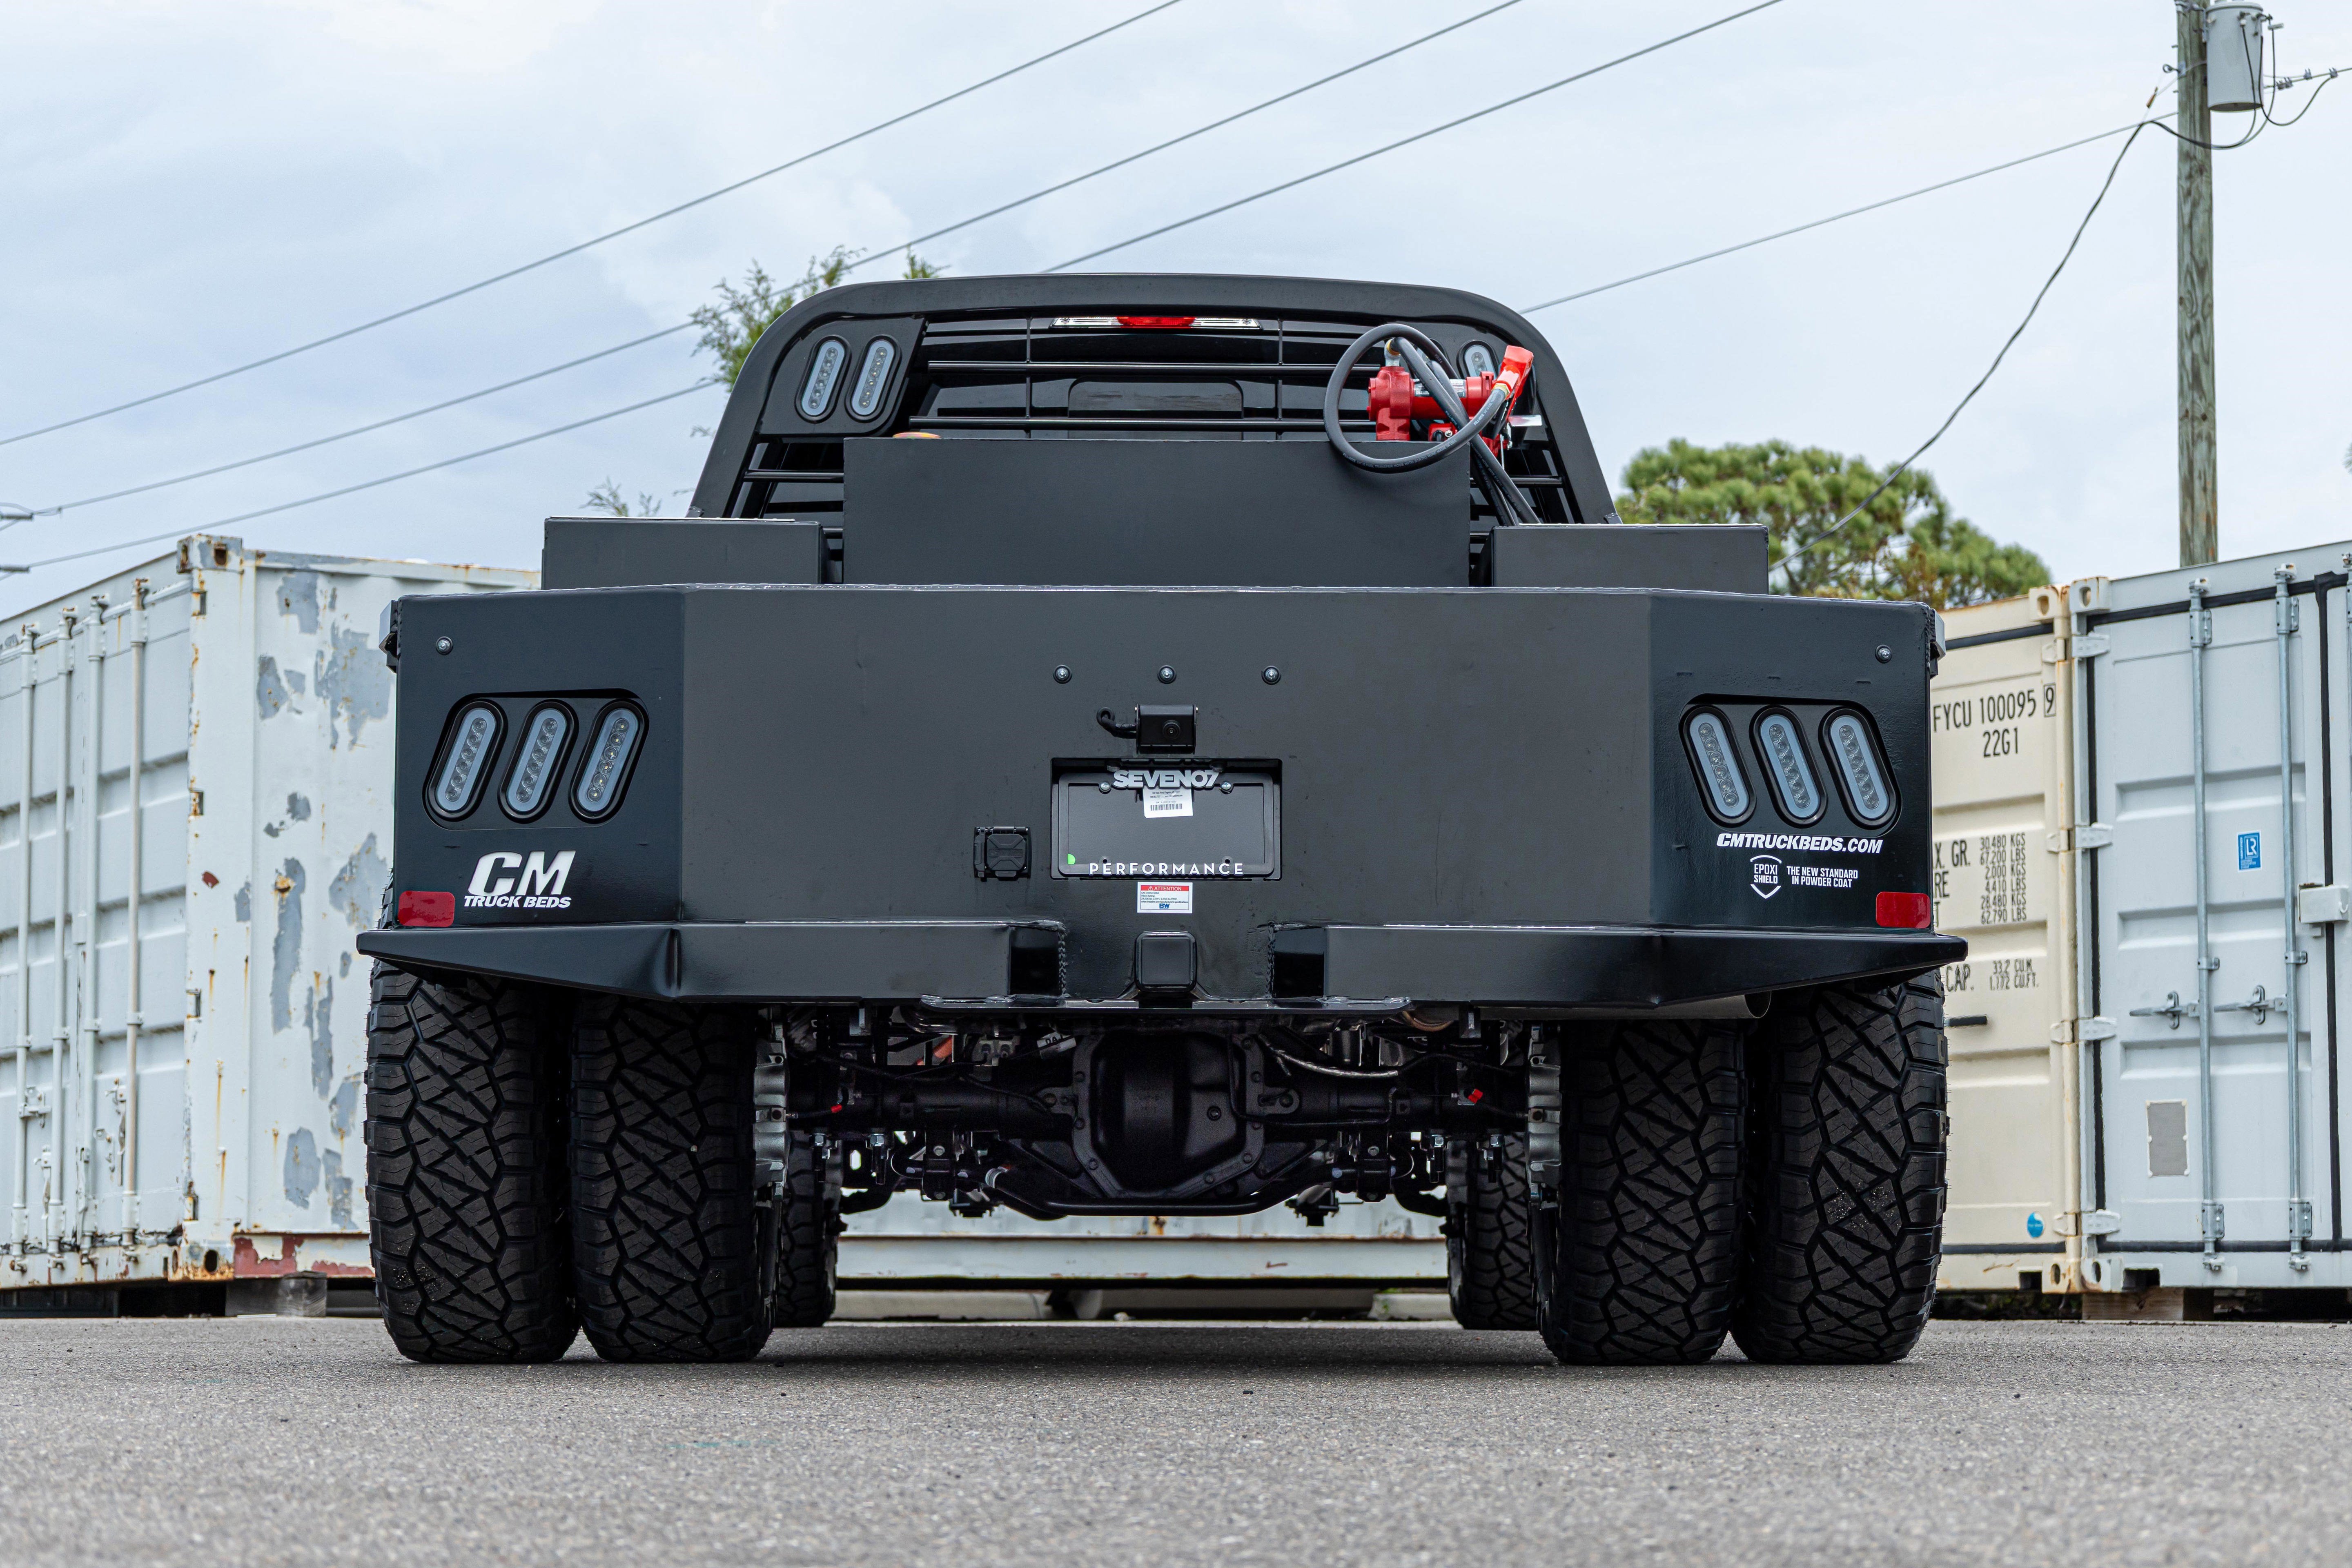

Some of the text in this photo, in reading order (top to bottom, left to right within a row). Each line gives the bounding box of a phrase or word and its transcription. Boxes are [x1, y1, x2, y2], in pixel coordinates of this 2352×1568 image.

[1933, 687, 2055, 732] FYCU 100095 9
[1982, 726, 2018, 757] 22G1
[1716, 833, 1883, 854] CMTRUCKBEDS.COM
[2011, 832, 2026, 847] KGS
[2246, 837, 2257, 856] LR
[1933, 839, 1971, 870] X. GR.
[2011, 847, 2026, 863] LBS
[468, 850, 576, 896] CM
[1089, 863, 1244, 876] PERFORMANCE
[1754, 863, 1778, 875] EPOXI
[1786, 865, 1858, 879] THE NEW STANDARD
[2011, 862, 2026, 877] KGS
[1753, 875, 1778, 884] SHIELD
[1791, 875, 1853, 888] IN POWDER COAT
[1934, 871, 1950, 898] RE
[2011, 878, 2027, 892] LBS
[464, 895, 572, 909] TRUCK BEDS
[2011, 892, 2027, 906] KGS
[2012, 907, 2027, 922] LBS
